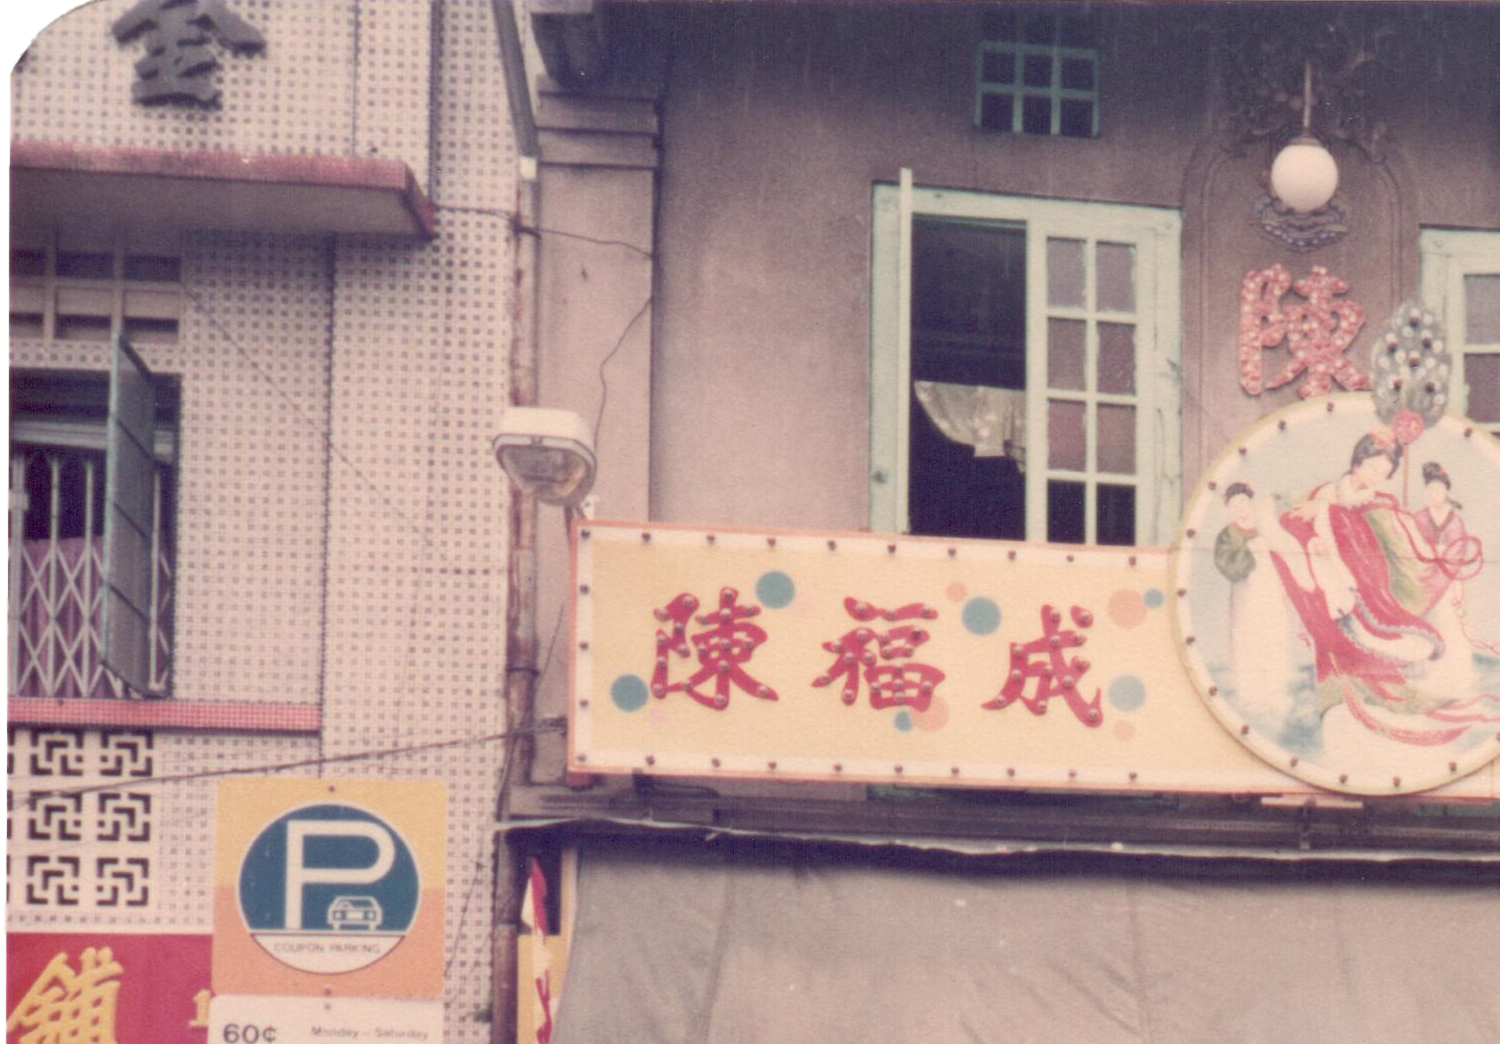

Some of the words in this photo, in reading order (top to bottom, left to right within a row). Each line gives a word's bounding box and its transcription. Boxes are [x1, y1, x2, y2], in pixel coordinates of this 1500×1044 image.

[1239, 263, 1373, 398] 陳
[651, 586, 1105, 728] 陳福成
[285, 820, 396, 930] P
[274, 942, 324, 953] COUPON
[330, 943, 380, 954] PARKING
[222, 1023, 277, 1044] 60¢
[311, 1026, 359, 1040] Monday
[374, 1026, 429, 1042] Saturday
